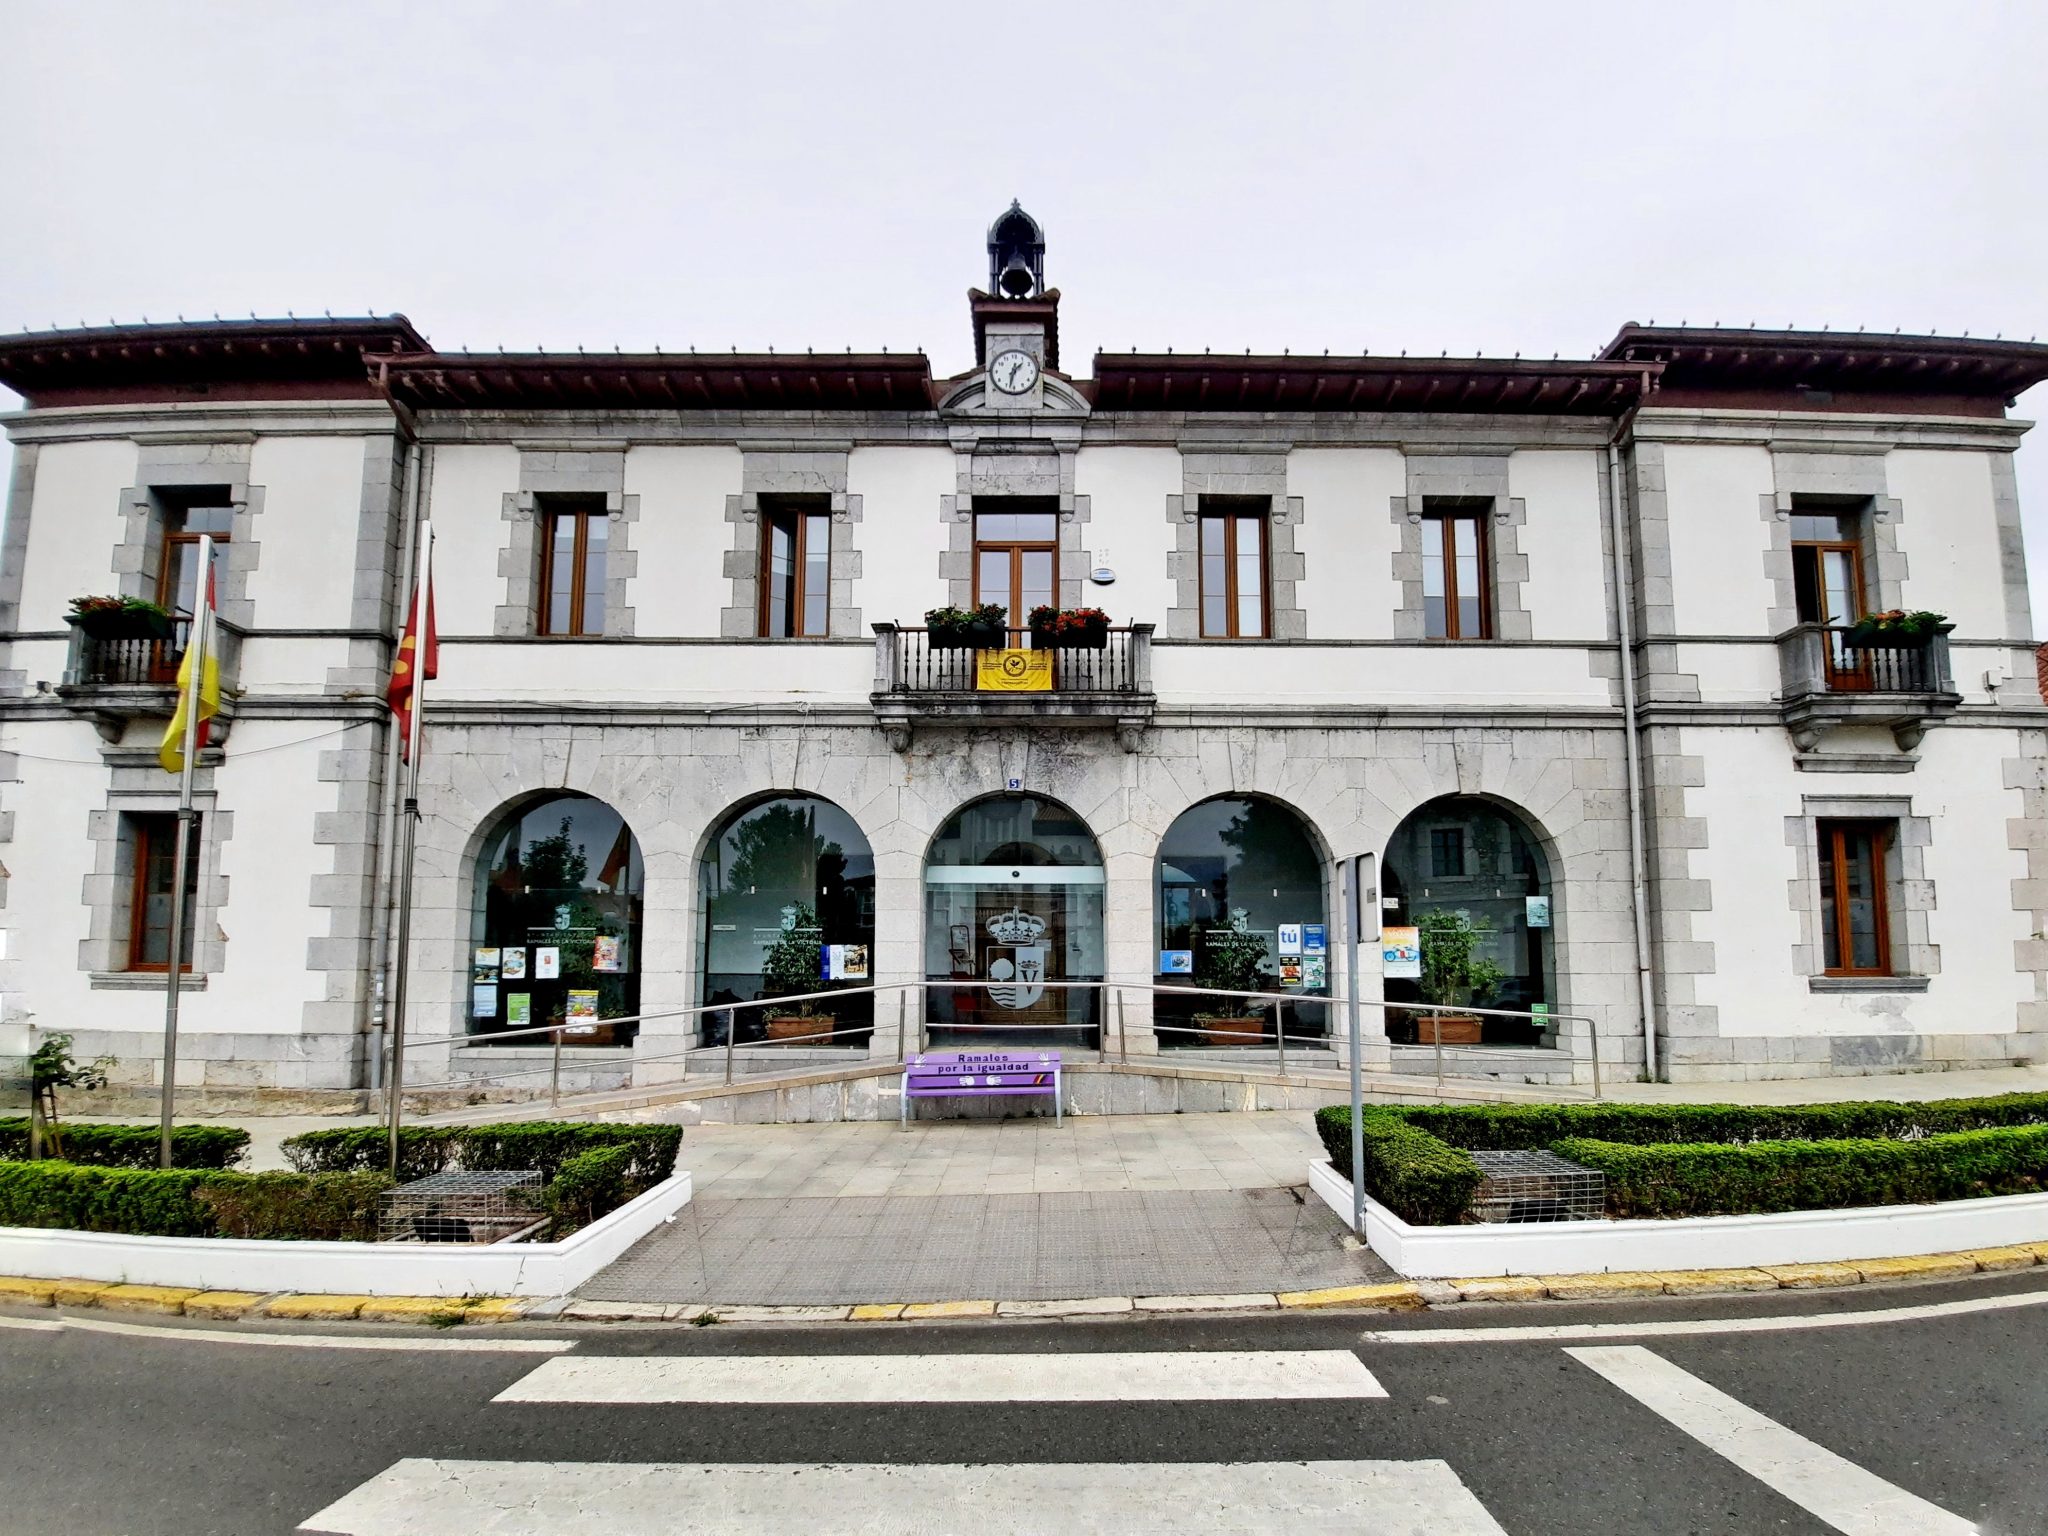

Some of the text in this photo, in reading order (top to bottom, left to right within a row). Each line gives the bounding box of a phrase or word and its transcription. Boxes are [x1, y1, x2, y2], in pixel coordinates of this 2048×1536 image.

[1010, 779, 1018, 788] 5
[1280, 929, 1297, 943] tú
[958, 1054, 1008, 1062] Ramales
[938, 1063, 1029, 1074] por la igualdad
